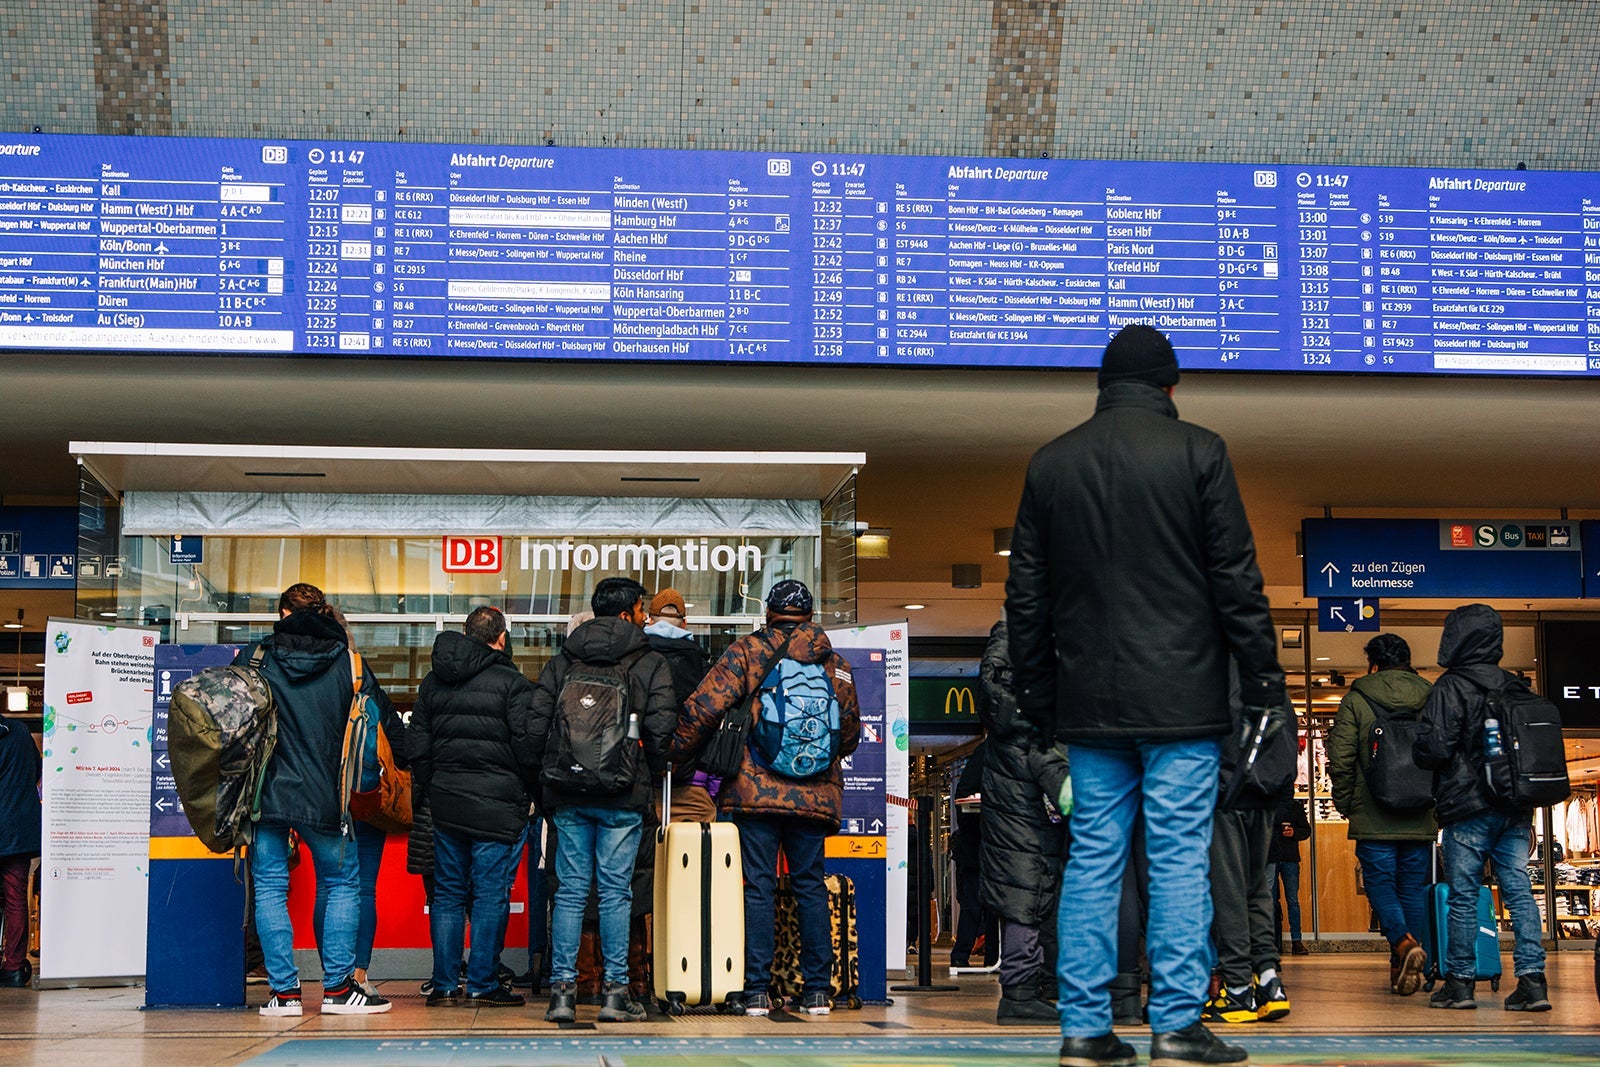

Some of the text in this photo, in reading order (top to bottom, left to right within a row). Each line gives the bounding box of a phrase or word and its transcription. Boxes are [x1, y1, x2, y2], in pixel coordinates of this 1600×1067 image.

[451, 154, 554, 170] Abfahrt Departure
[833, 163, 865, 176] 11:47
[949, 166, 1048, 182] Abfahrt Departure
[1317, 175, 1348, 187] 11:47
[1430, 178, 1526, 192] Abfahrt Departure
[56, 185, 93, 193] Euskirchen
[102, 185, 120, 196] Kall
[310, 190, 339, 200] 12:07
[450, 194, 486, 202] Düsseldorf
[507, 196, 536, 205] Duisburg
[558, 197, 576, 205] Essen
[615, 197, 687, 211] Minden (Westf)
[814, 202, 842, 212] 12:32
[102, 203, 194, 217] Hamm (Westf) Hbf
[310, 208, 338, 219] 12:11
[408, 211, 422, 219] 612
[1108, 208, 1162, 219] Koblenz Hbf
[615, 215, 656, 228] Hamburg
[660, 216, 676, 226] Hbf
[1300, 213, 1327, 223] 13:00
[101, 222, 216, 236] Wuppertal-Oberbarmen
[814, 220, 842, 230] 12:37
[310, 226, 338, 237] 12:15
[1108, 226, 1152, 237] Essen Hbf
[1300, 230, 1327, 240] 13:01
[614, 233, 668, 244] Aachen Hbf
[814, 237, 842, 248] 12:42
[910, 240, 928, 248] 9448
[101, 240, 151, 253] Köln/Bonn
[309, 244, 337, 255] 12:21
[1108, 244, 1154, 254] Paris Nord
[614, 251, 646, 262] Rheine
[1301, 248, 1328, 258] 13:07
[100, 258, 165, 270] München Hbf
[814, 255, 842, 266] 12:42
[309, 263, 337, 274] 12:24
[395, 266, 425, 274] ICE 2915
[1108, 262, 1160, 272] Krefeld Hbf
[1302, 266, 1328, 276] 13:08
[614, 269, 684, 280] Düsseldorf Hbf
[814, 273, 842, 284] 12:46
[100, 277, 197, 291] Frankfurt(Main)Hbf
[309, 281, 337, 292] 12:24
[1109, 279, 1125, 289] Kall
[1302, 283, 1328, 293] 13:15
[25, 295, 50, 303] Horrem
[99, 295, 128, 306] Düren
[614, 288, 634, 298] Köln
[637, 288, 684, 302] Hansaring
[815, 291, 842, 302] 12:49
[308, 299, 336, 310] 12:25
[1109, 297, 1194, 310] Hamm (Westf) Hbf
[1302, 301, 1329, 311] 13:17
[1394, 304, 1412, 312] 2939
[614, 306, 724, 318] Wuppertal-Oberbarmen
[815, 309, 842, 320] 12:52
[42, 314, 73, 322] Troisdorf
[98, 314, 144, 328] Au (Sieg)
[308, 318, 336, 328] 12:25
[1109, 315, 1216, 327] Wuppertal-Oberbarmen
[1303, 318, 1329, 329] 13:21
[614, 324, 718, 338] Mönchengladbach Hbf
[815, 327, 842, 338] 12:53
[910, 330, 927, 338] 2944
[950, 331, 986, 339] Ersatzfahrt
[1011, 332, 1028, 340] 1944
[307, 336, 335, 347] 12:31
[1303, 336, 1330, 346] 13:24
[1396, 339, 1414, 347] 9423
[614, 342, 689, 353] Oberhausen Hbf
[815, 345, 842, 356] 12:58
[1304, 354, 1331, 364] 13:24
[1478, 526, 1494, 546] S
[450, 537, 761, 572] DB Information
[1352, 562, 1425, 576] zu den Zügen
[1352, 577, 1413, 588] koelnmesse
[1354, 598, 1364, 620] 1
